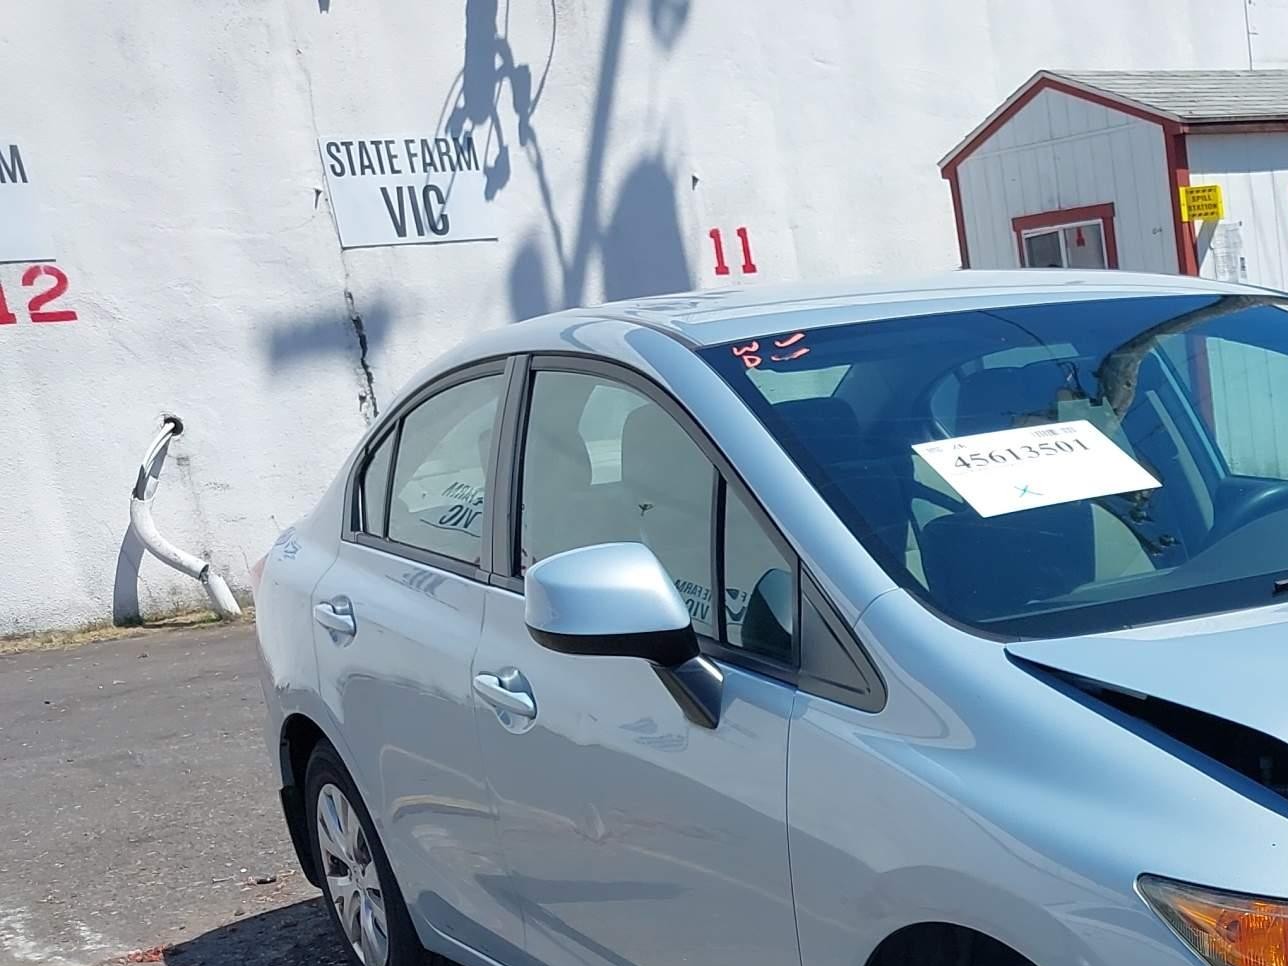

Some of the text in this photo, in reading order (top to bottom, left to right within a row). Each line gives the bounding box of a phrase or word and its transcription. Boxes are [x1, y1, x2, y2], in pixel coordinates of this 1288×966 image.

[326, 136, 480, 177] STATE FARM
[380, 183, 450, 238] VIC
[1188, 203, 1217, 211] STATION
[1191, 194, 1212, 202] SPILL
[709, 227, 757, 275] 11
[953, 438, 1090, 469] 45613501
